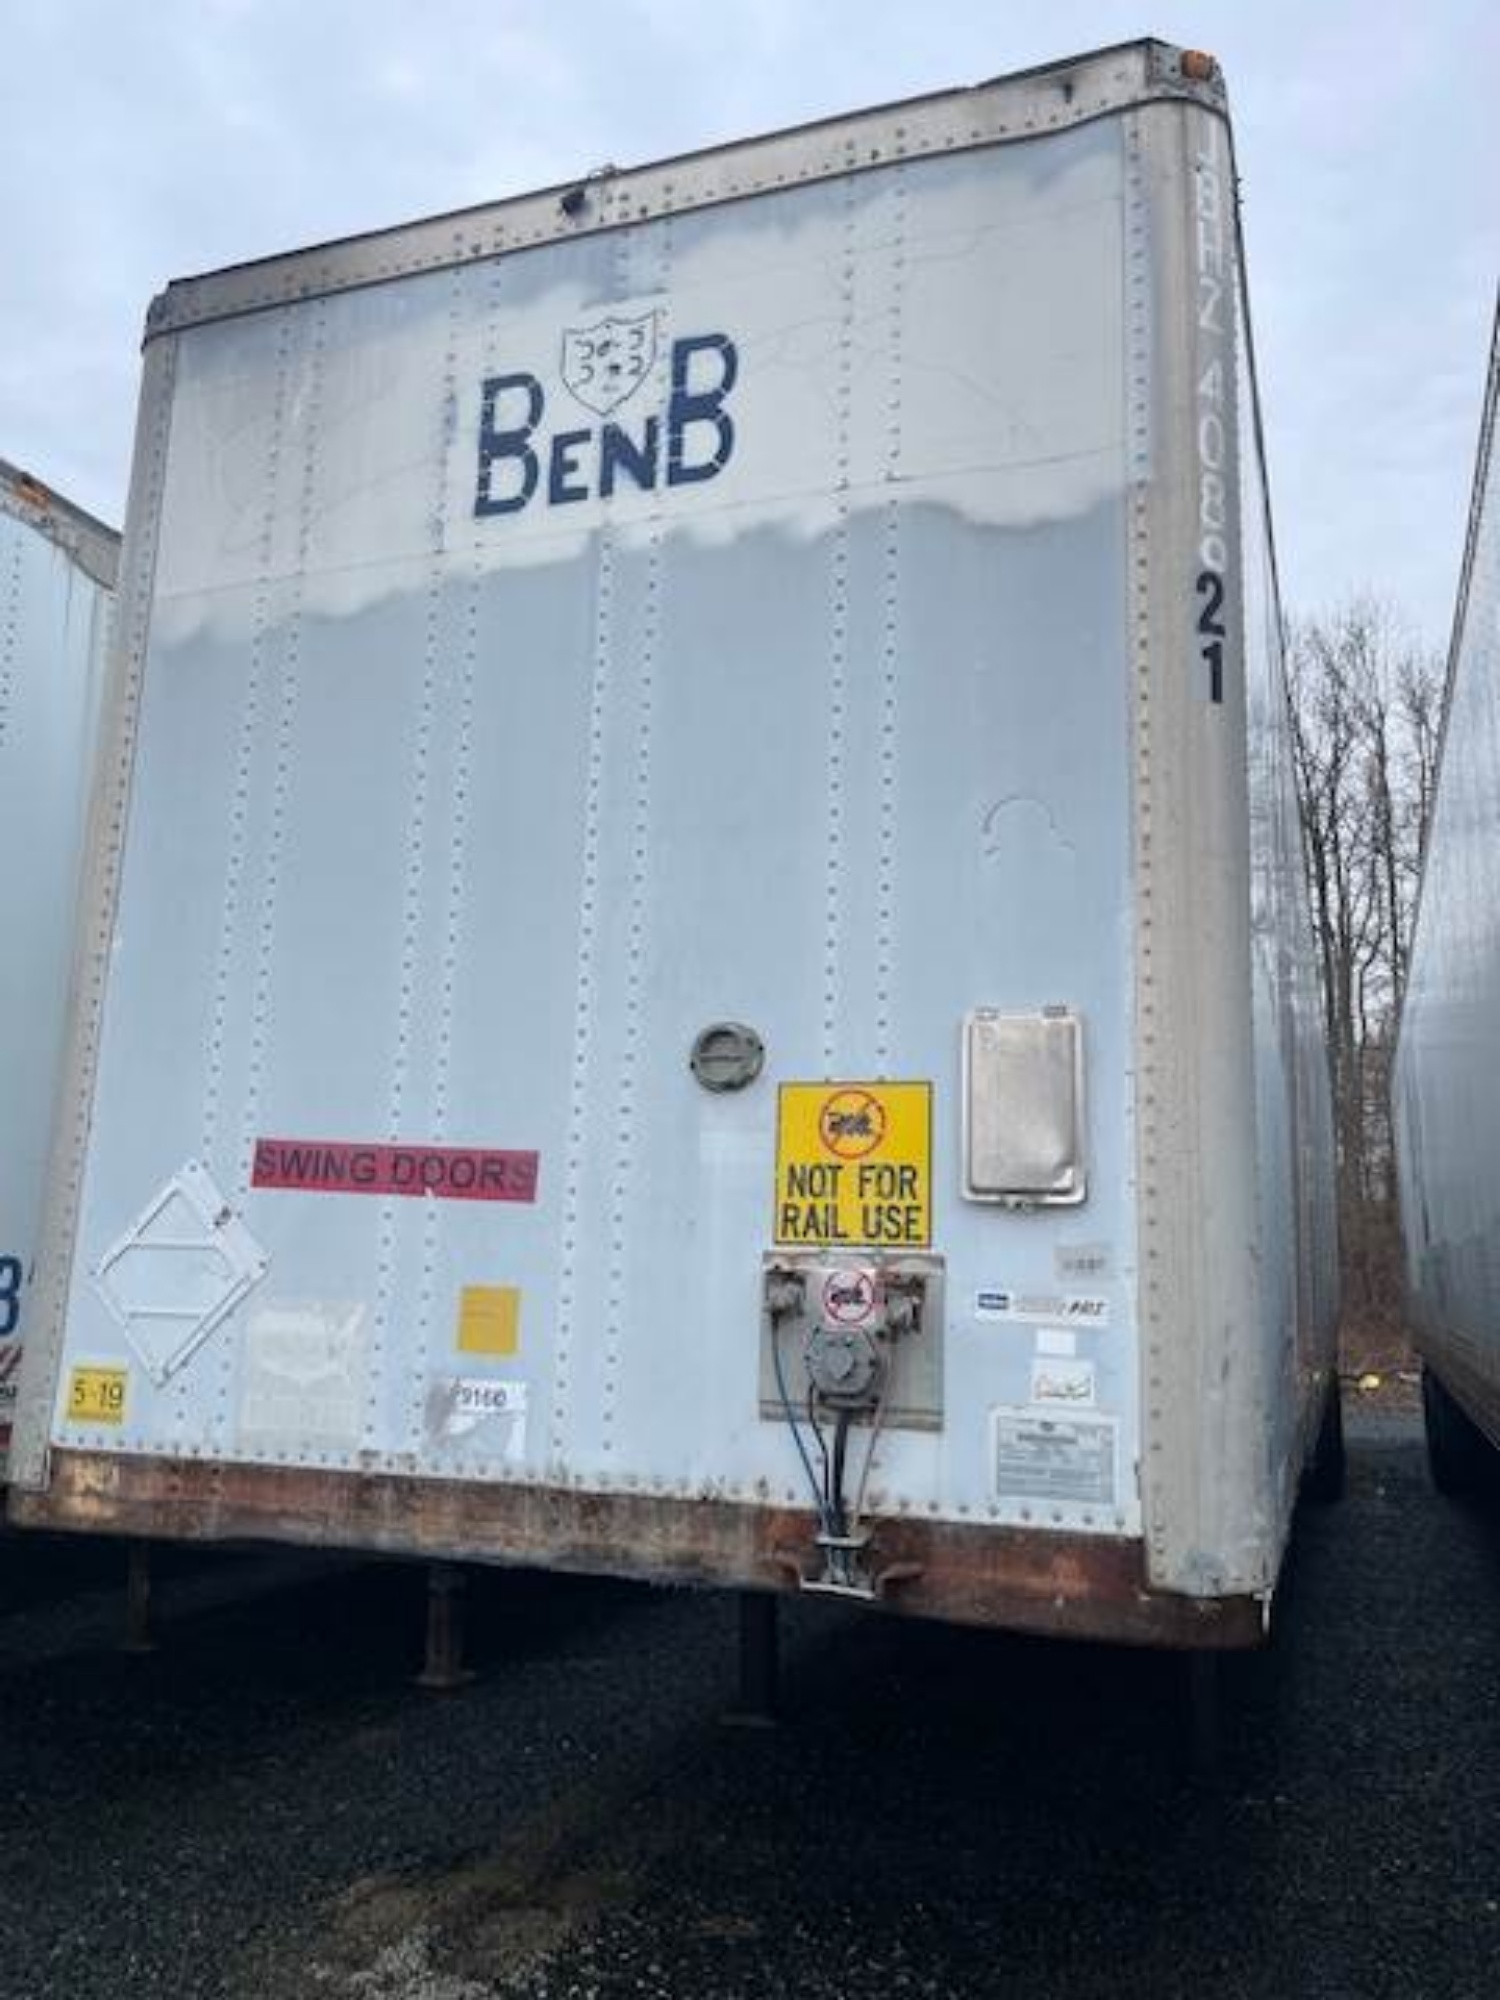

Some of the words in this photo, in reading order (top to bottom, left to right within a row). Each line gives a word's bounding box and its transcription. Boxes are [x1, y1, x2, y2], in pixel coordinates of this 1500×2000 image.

[254, 1146, 377, 1184] SWING
[391, 1152, 537, 1192] DOORS
[786, 1163, 843, 1199] NOT
[859, 1164, 918, 1201] FOR
[780, 1202, 848, 1239] RAIL
[862, 1204, 923, 1241] USE
